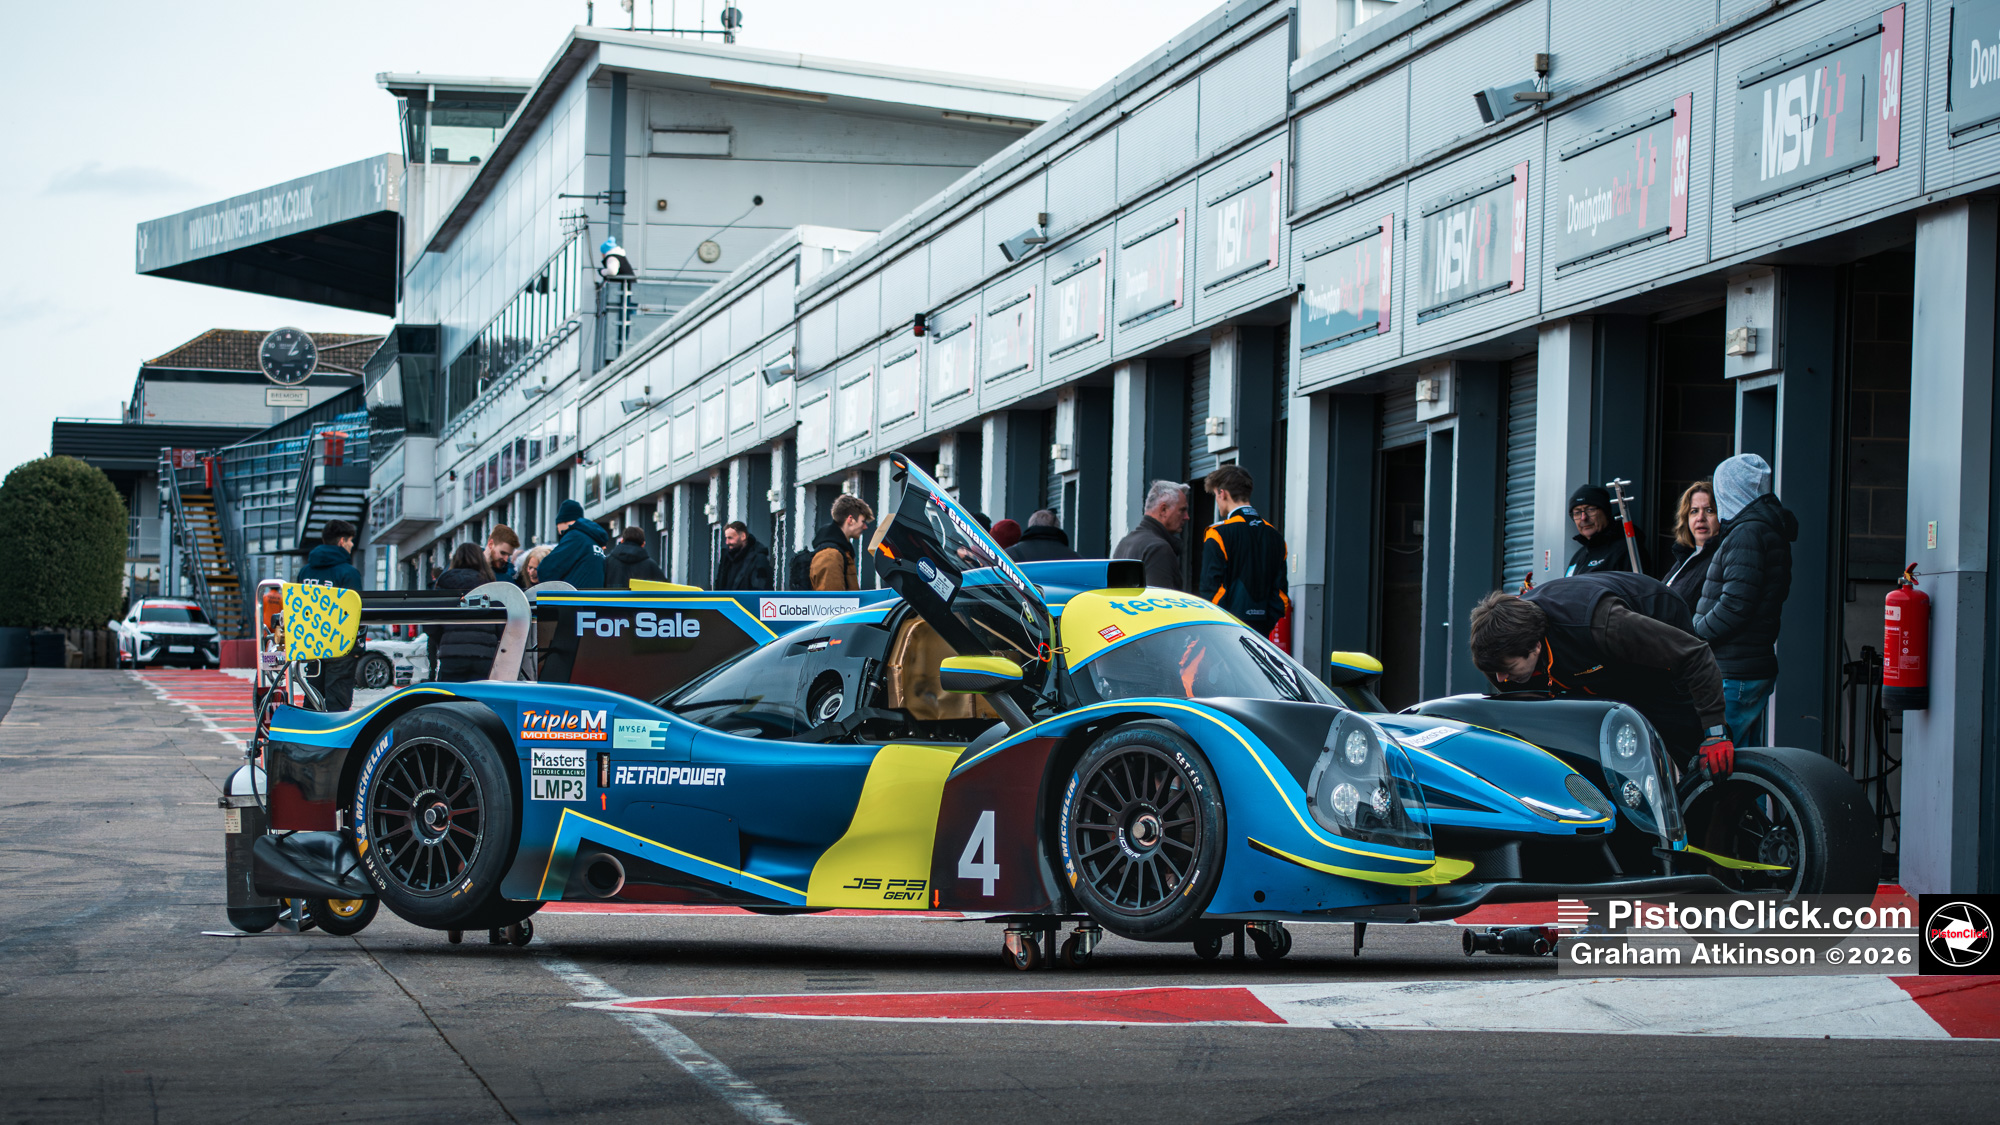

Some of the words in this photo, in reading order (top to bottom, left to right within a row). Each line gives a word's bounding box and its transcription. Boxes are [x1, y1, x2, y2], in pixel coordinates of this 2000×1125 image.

[1883, 49, 1899, 121] 34
[1761, 69, 1822, 181] MSV
[1674, 134, 1688, 198] 33
[189, 186, 313, 250] WWW.DONINGTON-PARK.CO.UK
[1217, 198, 1245, 272] MSV
[1514, 201, 1527, 254] 32
[1436, 207, 1476, 295] MSV
[948, 507, 996, 560] Grahame
[997, 555, 1025, 591] Tilley
[285, 586, 350, 653] tecserv
[576, 611, 630, 637] For
[635, 611, 700, 638] Sale
[523, 732, 605, 741] MOTORSPORT
[533, 751, 585, 767] Masters
[618, 725, 647, 733] MYSEA
[356, 735, 389, 821] MICHELIN
[534, 779, 584, 800] LMP3
[615, 766, 726, 786] RETROPOWER
[1061, 777, 1077, 858] MICHELIN
[1118, 826, 1141, 859] LIGIER
[843, 877, 883, 890] JS
[886, 879, 928, 891] P3
[958, 810, 1000, 897] 4
[883, 891, 916, 901] GEN
